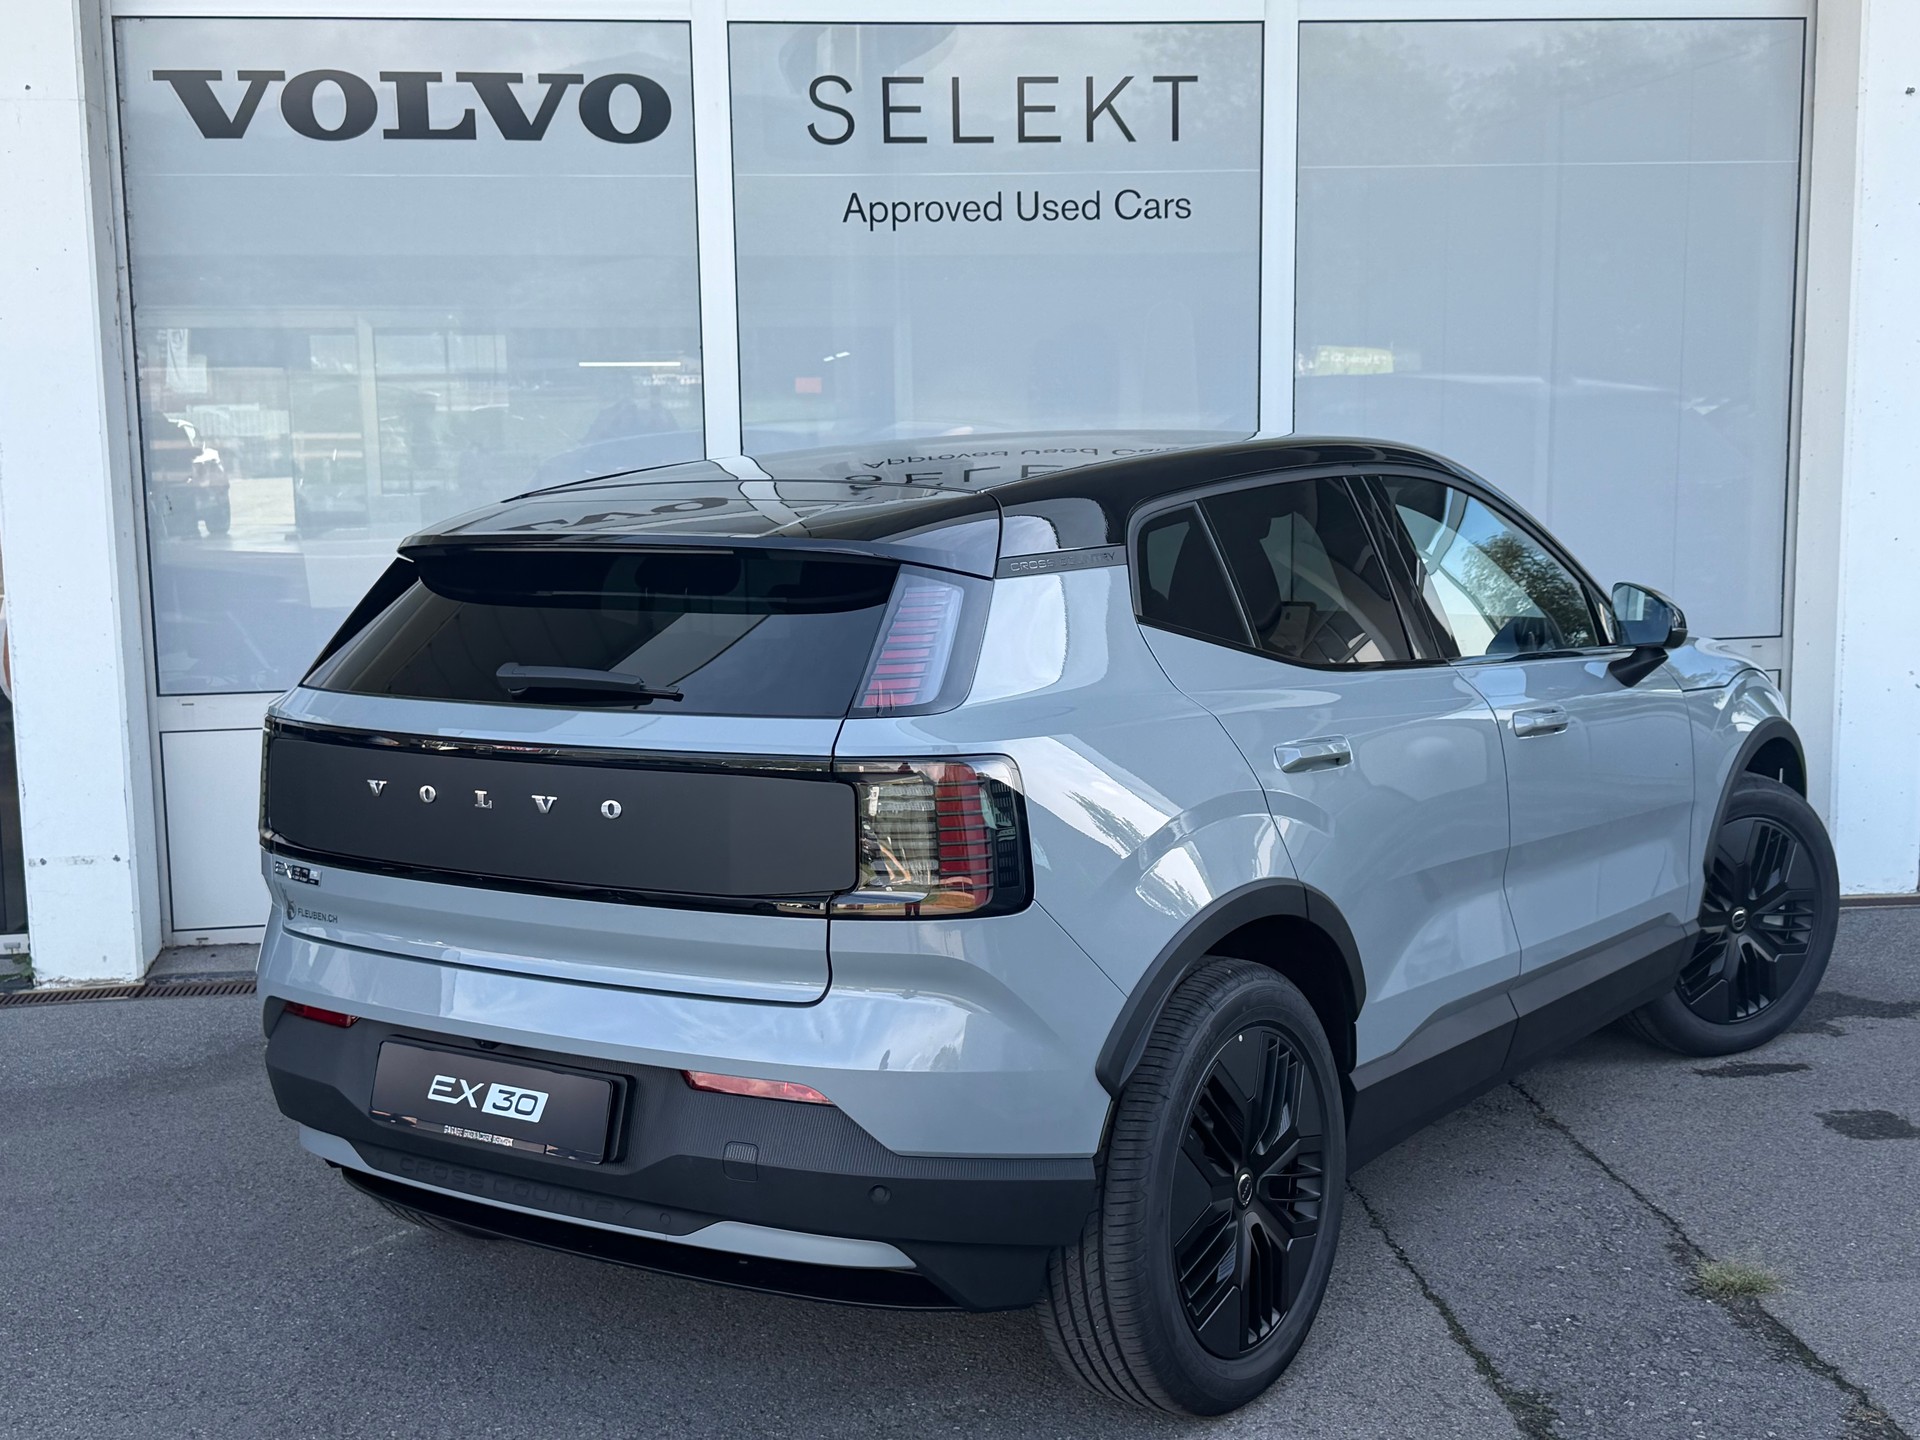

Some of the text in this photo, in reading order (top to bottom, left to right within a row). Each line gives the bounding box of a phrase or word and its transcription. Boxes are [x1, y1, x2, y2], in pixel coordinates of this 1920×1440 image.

[152, 69, 673, 144] VOLVO
[807, 75, 1198, 145] SELEKT
[842, 189, 1192, 232] Approved Used Cars
[1010, 559, 1054, 572] CROSS
[367, 779, 622, 819] VOLVO
